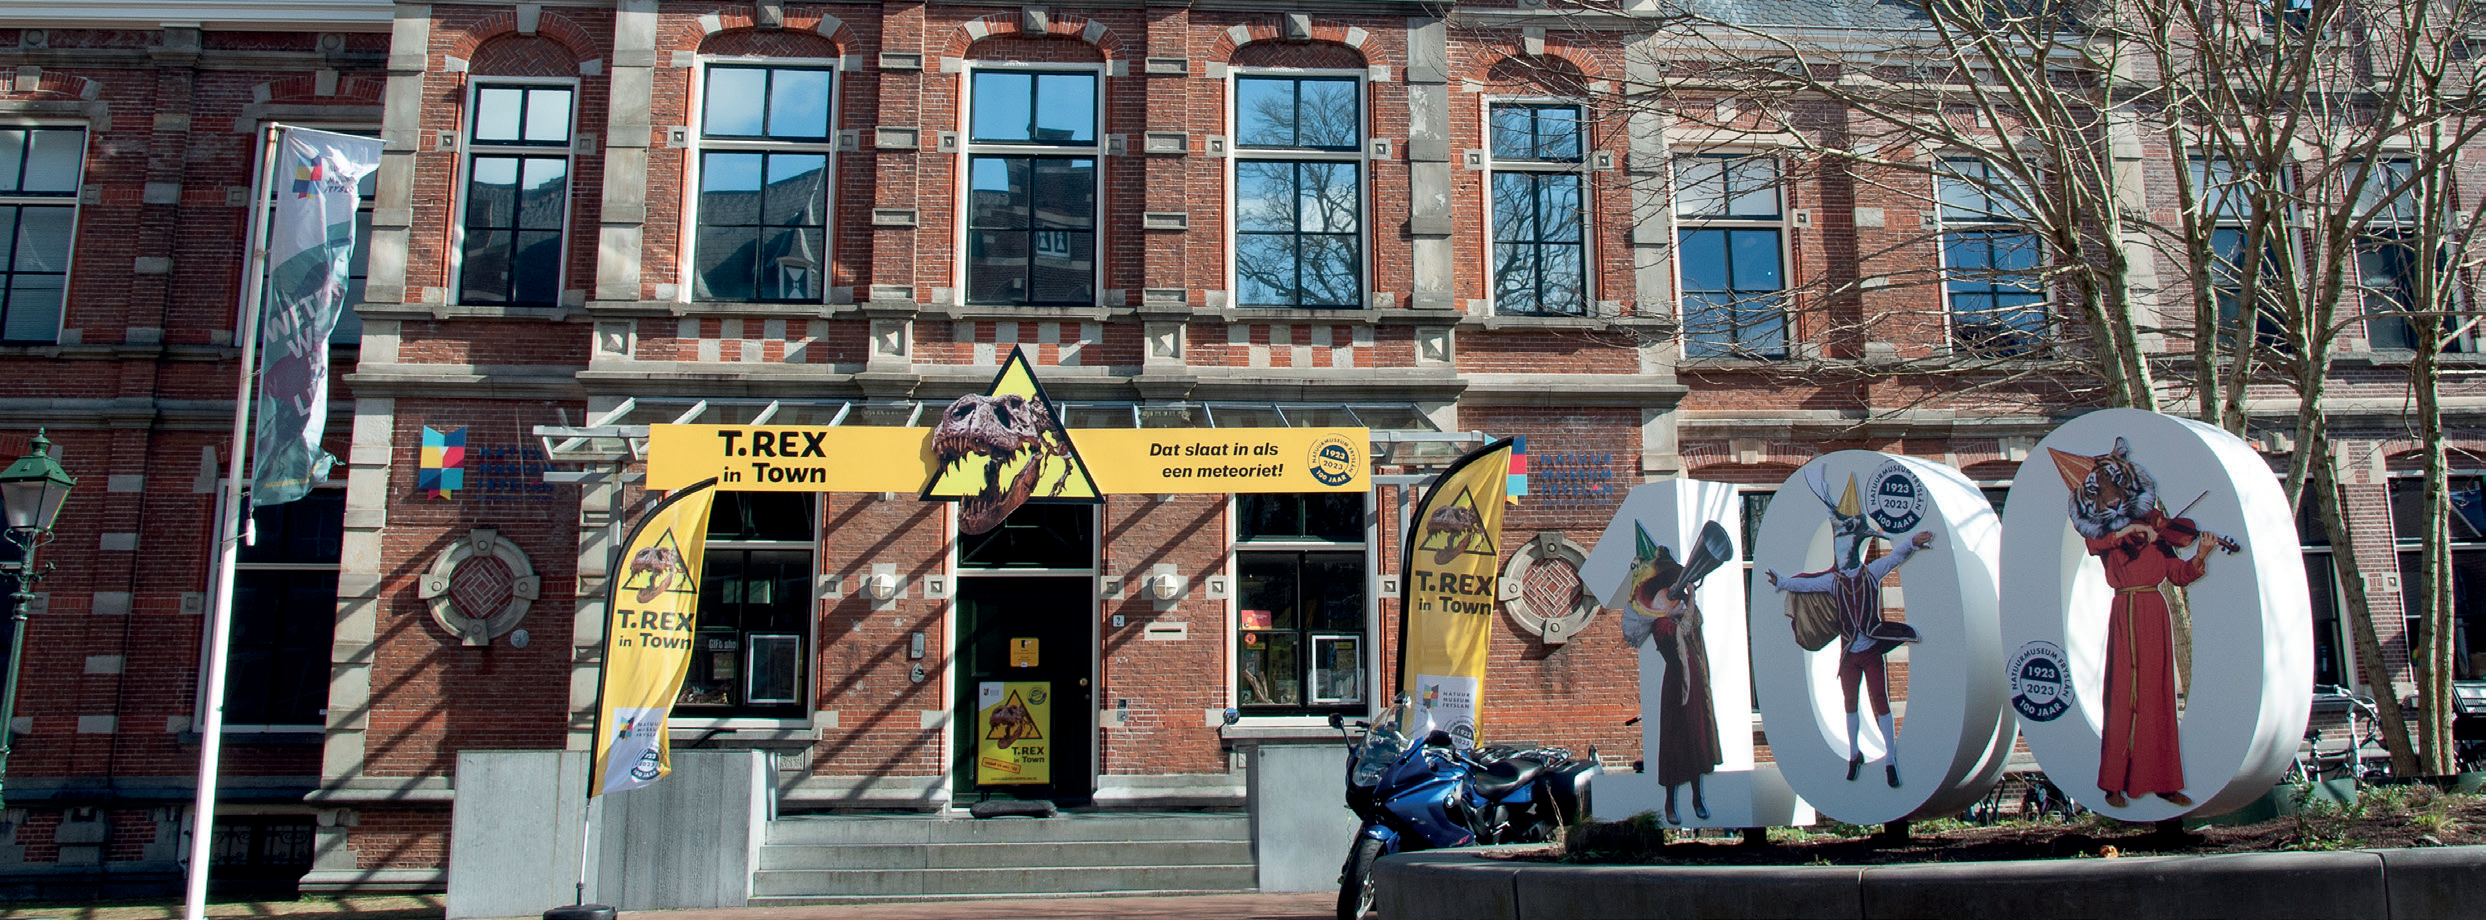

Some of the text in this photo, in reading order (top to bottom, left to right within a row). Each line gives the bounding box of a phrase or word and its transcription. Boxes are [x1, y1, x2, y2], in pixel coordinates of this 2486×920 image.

[717, 429, 828, 458] T.REX
[1149, 442, 1279, 456] Dat slaat in als
[1325, 448, 1346, 460] 1923
[1540, 453, 1612, 465] NATUUR
[1162, 463, 1284, 478] een meteoriet!
[1323, 460, 1343, 470] 2023
[723, 462, 827, 483] in Town
[1316, 470, 1347, 483] 100 JAAR
[1541, 468, 1613, 480] MUSEUM
[1870, 464, 1912, 506] NATUURMUSEUM
[1885, 482, 1910, 494] 1923
[1884, 498, 1909, 510] 2023
[1877, 513, 1915, 529] 100 JAAR
[1415, 570, 1494, 597] T.REX
[1418, 595, 1492, 616] in Town
[617, 609, 695, 632] T.REX
[1578, 408, 2313, 828] 100
[619, 632, 692, 650] in Town
[2010, 647, 2058, 690] NATUURMUSEUM
[2028, 666, 2055, 679] 1923
[2026, 683, 2055, 696] 2023
[2019, 699, 2062, 717] 100 JAAR
[1456, 728, 1472, 738] 1923
[1454, 737, 1470, 746] 2023
[1011, 746, 1045, 755] T.REX
